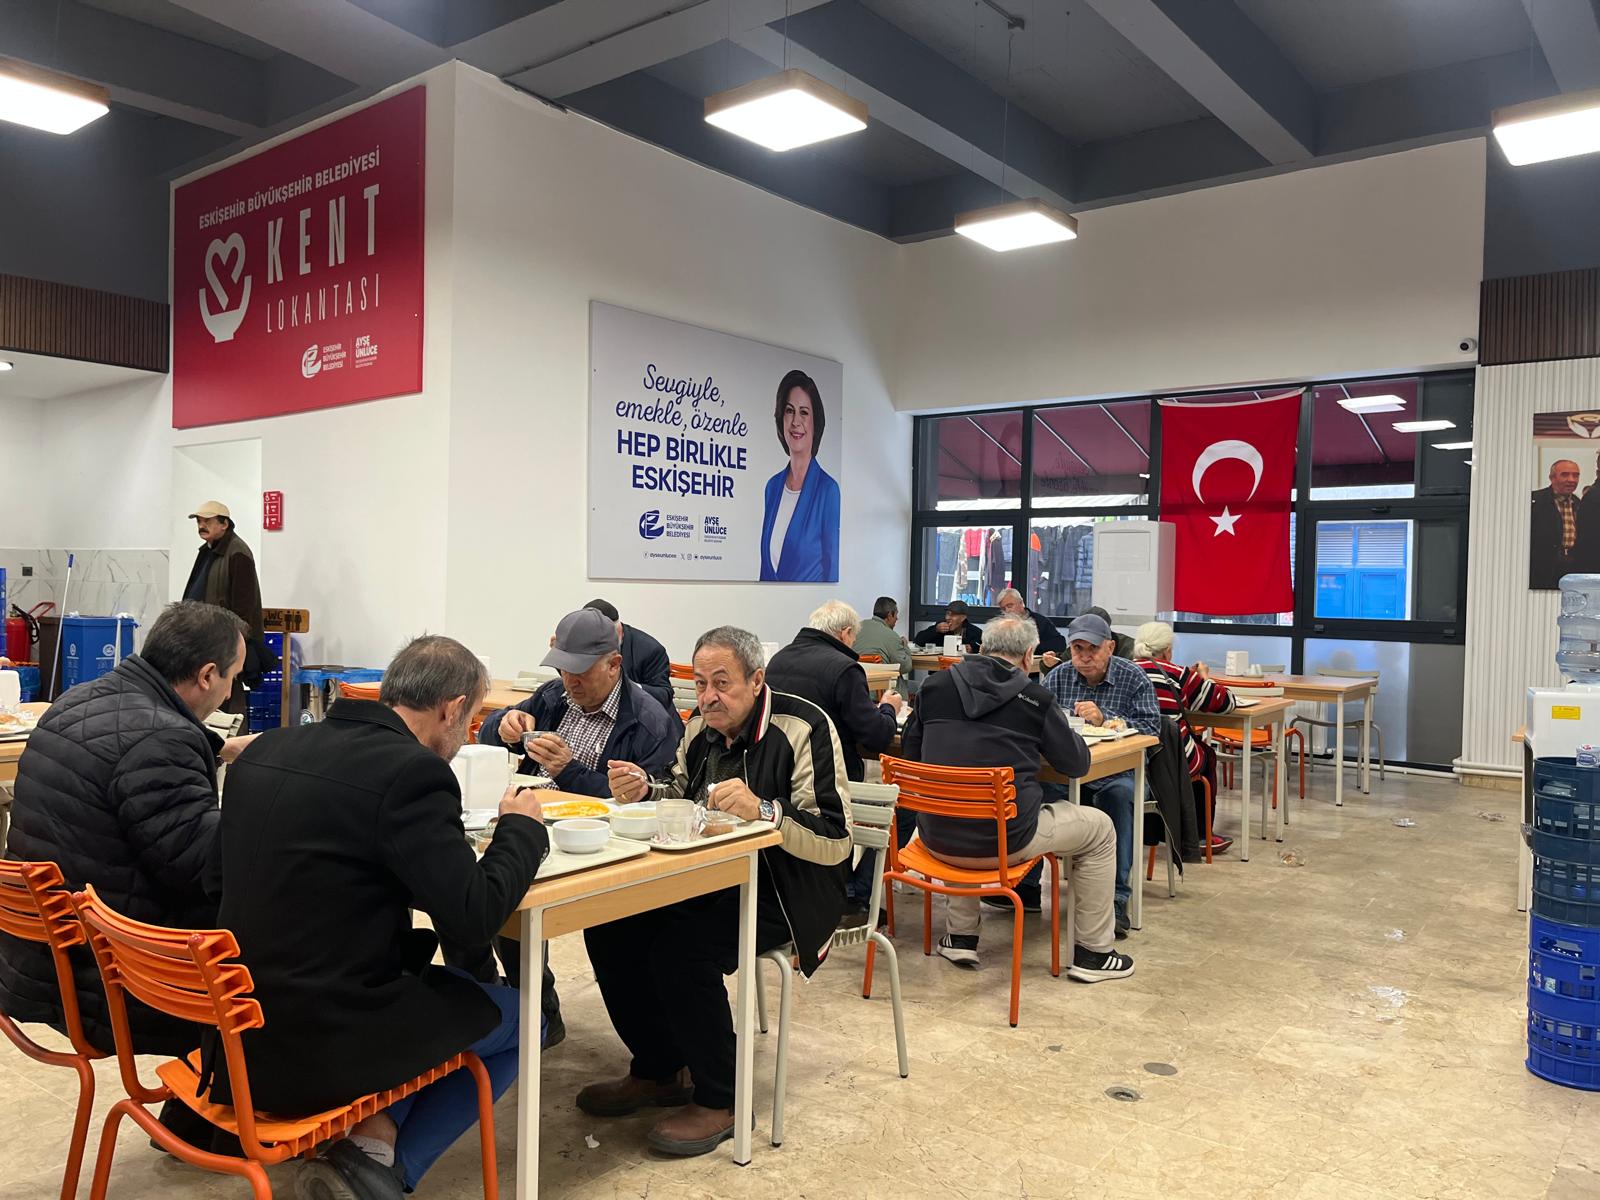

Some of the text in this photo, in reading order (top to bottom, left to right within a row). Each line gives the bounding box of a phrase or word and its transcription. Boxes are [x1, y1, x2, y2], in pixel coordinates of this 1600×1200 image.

[199, 145, 380, 229] ESKİŞEHİR BÜYÜKŞEHİR BELEDİYESİ
[267, 184, 380, 284] KENT
[267, 273, 379, 333] LOKANTASI
[643, 363, 725, 408] Sevgiyle,
[616, 398, 748, 437] emekle, özenle
[617, 429, 747, 470] HEP BİRLİKLE
[632, 463, 734, 498] ESKİŞEHİR
[267, 610, 283, 620] WC
